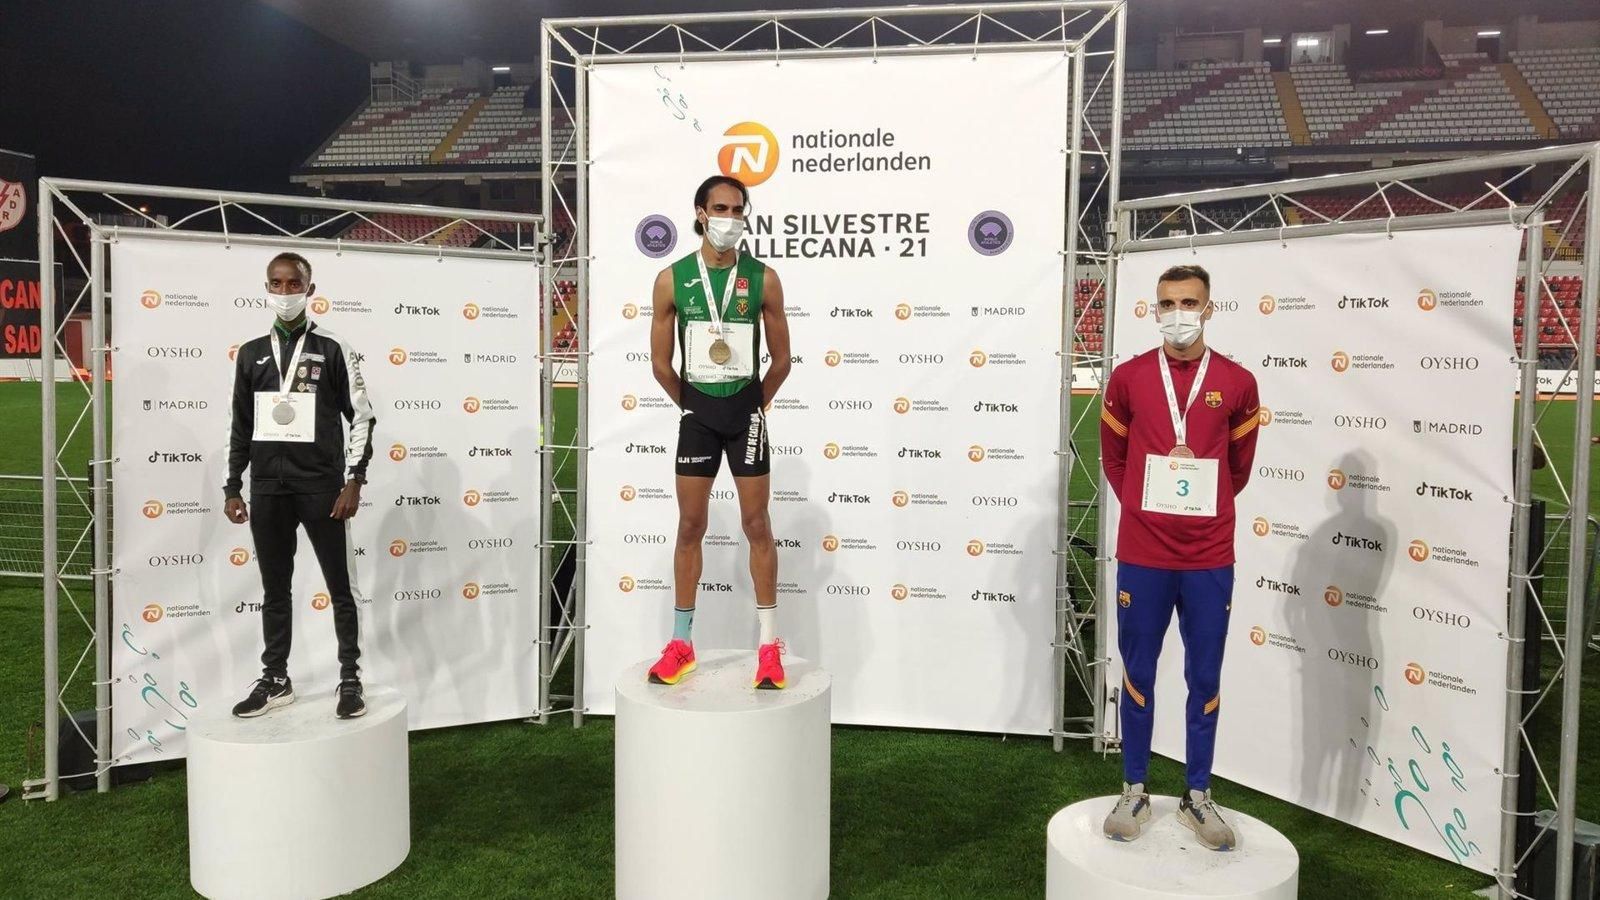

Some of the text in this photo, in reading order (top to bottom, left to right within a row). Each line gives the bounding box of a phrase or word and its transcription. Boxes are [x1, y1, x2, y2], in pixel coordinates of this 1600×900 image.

[792, 128, 894, 149] nationale
[792, 151, 930, 173] nederlanden
[741, 213, 930, 235] AN SILVESTRE
[738, 237, 927, 258] ALLECANA 21
[1439, 291, 1472, 299] nationale
[1278, 304, 1316, 312] nederlanden
[1350, 298, 1389, 309] TikTok
[1440, 299, 1484, 307] nederlanden
[406, 306, 440, 316] TikTok
[841, 309, 873, 318] TikTok
[984, 307, 1025, 316] MADRID
[147, 347, 202, 358] OYSHO
[477, 355, 516, 363] MADRID
[899, 354, 943, 364] OYSHO
[1273, 357, 1307, 367] TikTok
[1352, 354, 1384, 362] nationale
[1420, 357, 1479, 370] OYSHO
[159, 400, 208, 409] MADRID
[394, 400, 441, 410] OYSHO
[829, 400, 872, 410] OYSHO
[985, 403, 1018, 412] TikTok
[1275, 417, 1312, 425] nederlanden
[1334, 415, 1386, 429] OYSHO
[1429, 422, 1482, 435] MADRID
[480, 448, 512, 457] TikTok
[636, 445, 666, 453] TikTok
[770, 446, 803, 455] YSHO
[162, 453, 202, 463] TikTok
[909, 450, 941, 459] TikTok
[1259, 466, 1305, 482] OYSHO
[1349, 474, 1380, 484] nationale
[1176, 480, 1189, 496] 3
[1349, 481, 1391, 492] nederlanden
[1430, 485, 1473, 501] TikTok
[407, 497, 441, 506] TikTok
[839, 494, 871, 504] TikTok
[972, 496, 1018, 506] OYSHO
[167, 506, 211, 514] nederlanden
[1272, 521, 1299, 531] nationale
[624, 534, 666, 544] OYSHO
[1272, 529, 1309, 540] nederlanden
[468, 538, 513, 550] OYSHO
[897, 541, 941, 551] OYSHO
[1345, 535, 1383, 551] TikTok
[1432, 546, 1467, 557] nationale
[149, 554, 204, 567] OYSHO
[1432, 554, 1479, 568] nederlanden
[702, 583, 732, 592] TikTok
[827, 585, 870, 595] OYSHO
[1267, 580, 1301, 596] TikTok
[394, 589, 441, 601] OYSHO
[983, 592, 1016, 602] TikTok
[1346, 591, 1376, 602] nationale
[1346, 599, 1388, 614] nederlanden
[167, 610, 210, 618] nederlanden
[1413, 606, 1471, 629] OYSHO
[1269, 632, 1296, 644] nationale
[1269, 639, 1306, 654] nederlanden
[1328, 648, 1379, 670] OYSHO
[1428, 670, 1464, 684] nationale
[1428, 677, 1477, 695] nederlanden
